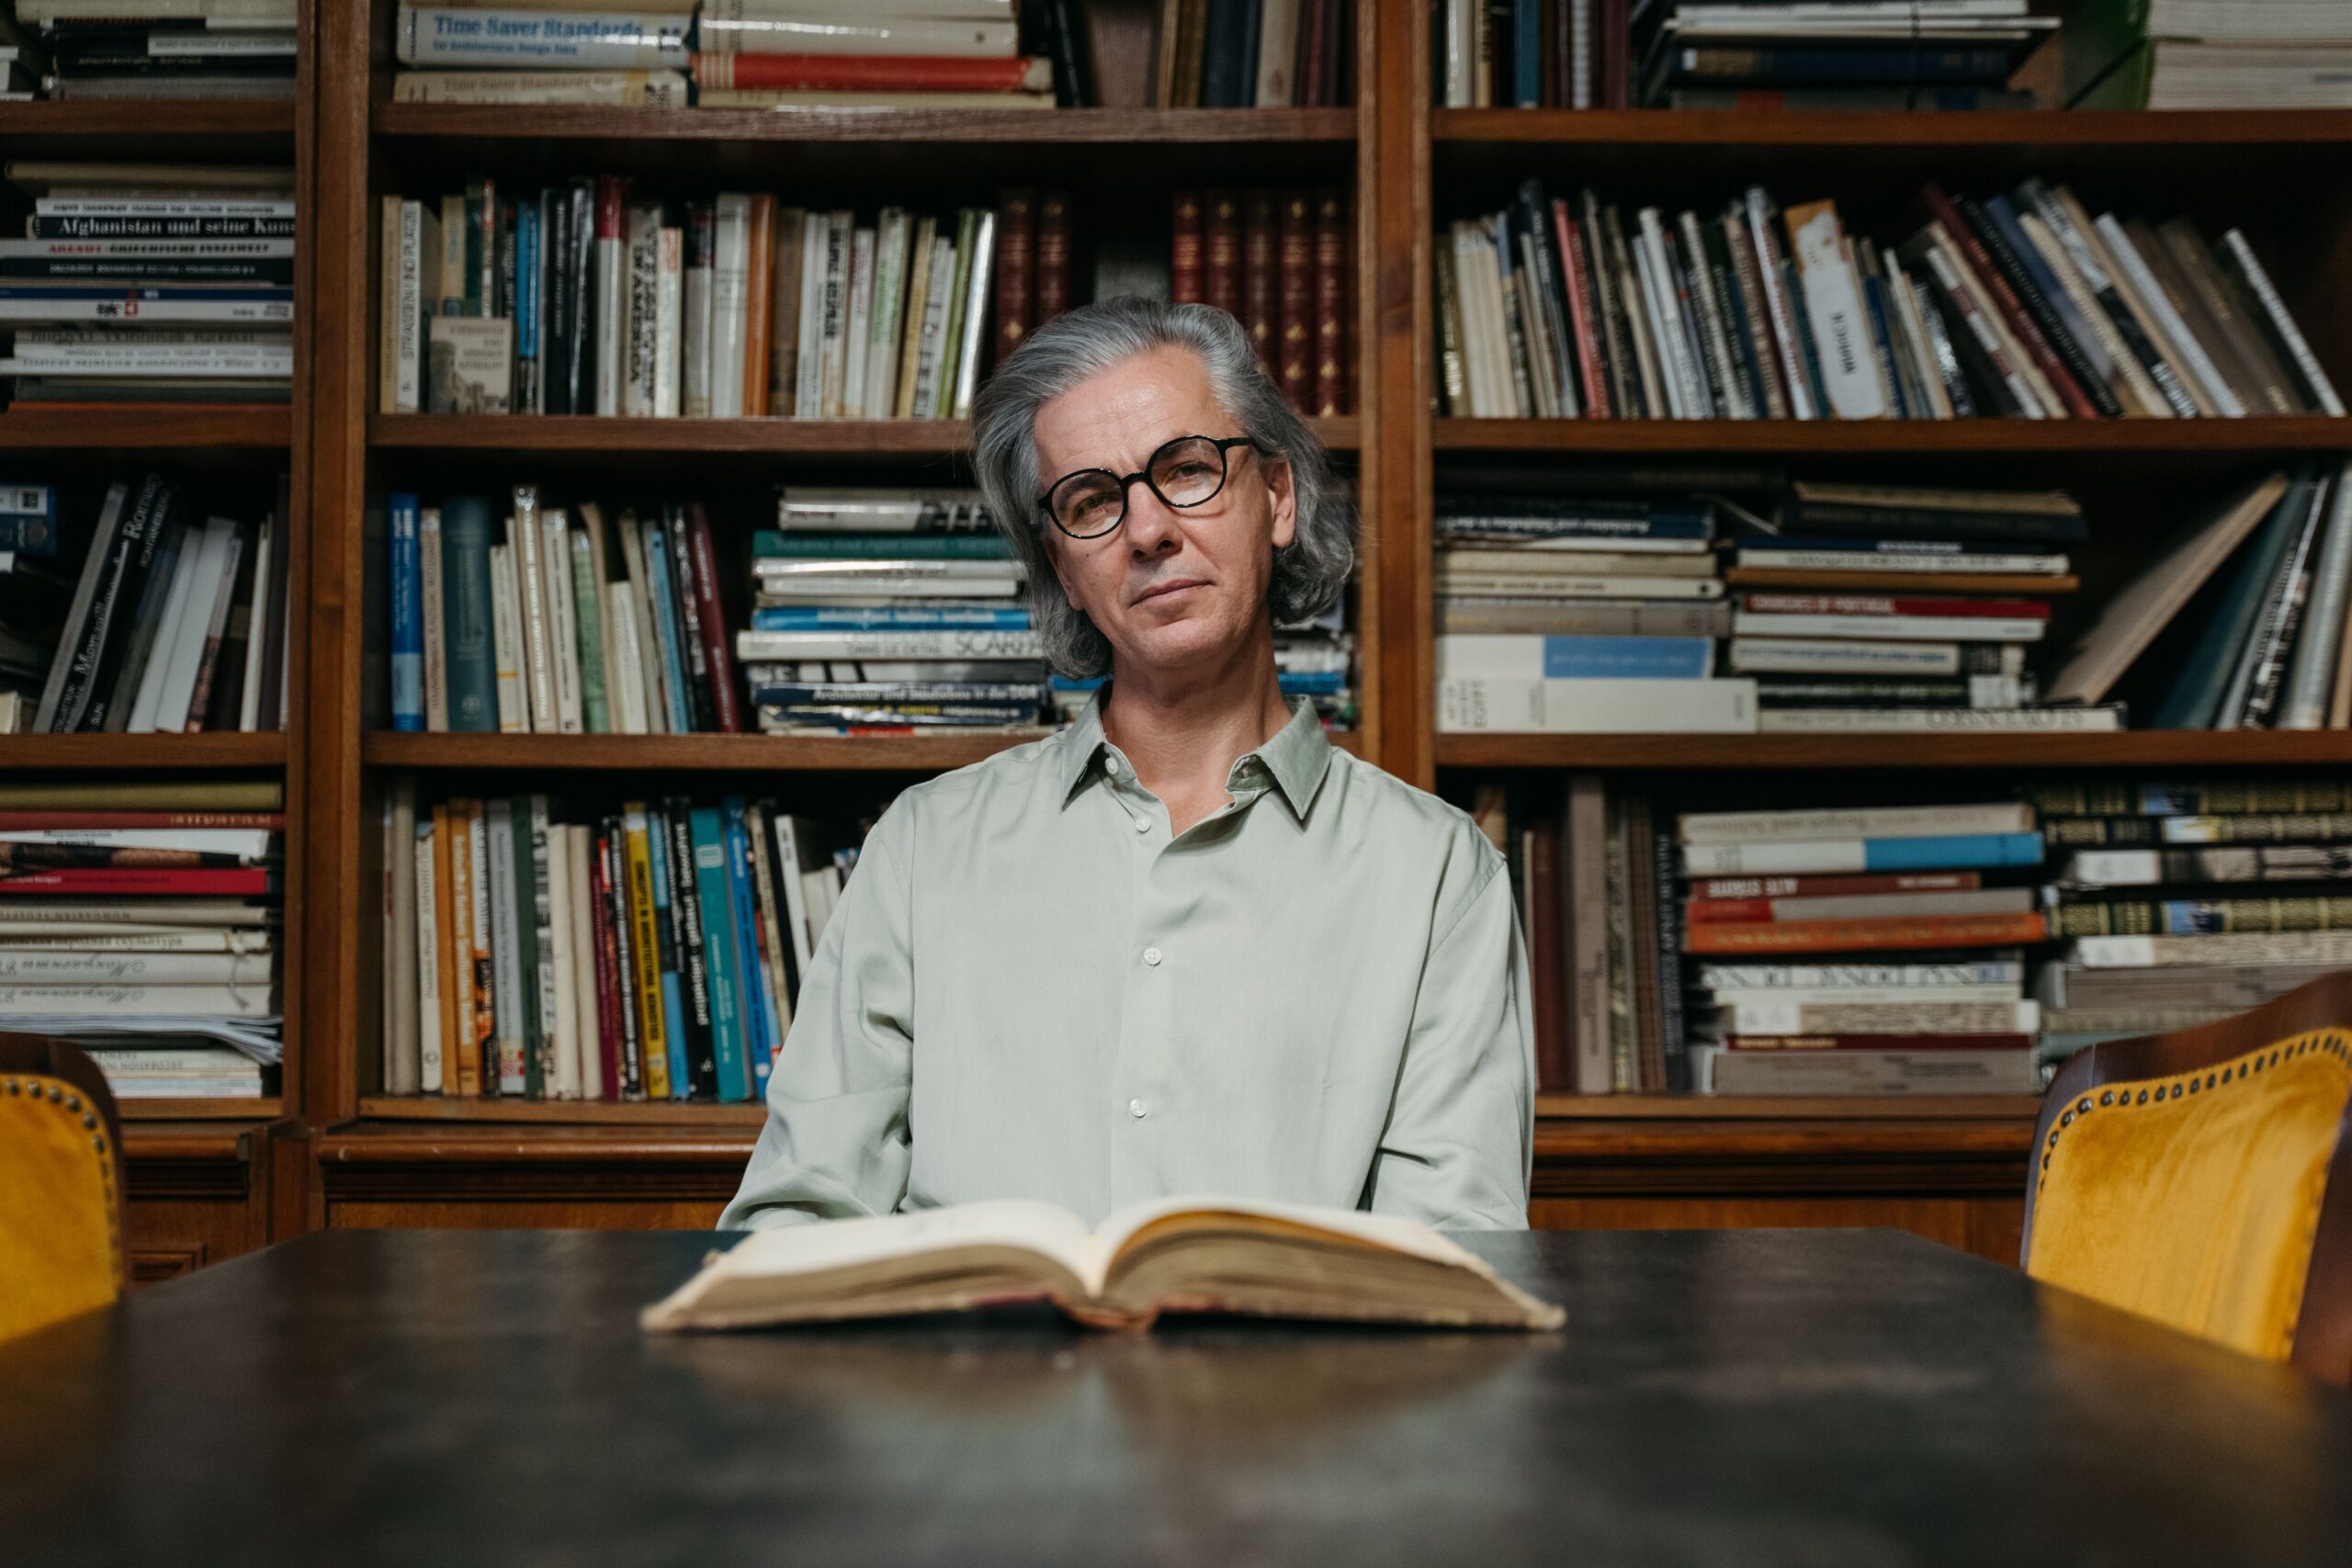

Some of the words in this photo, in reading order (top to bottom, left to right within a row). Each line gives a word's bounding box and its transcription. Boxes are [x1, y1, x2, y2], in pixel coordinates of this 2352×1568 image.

[434, 14, 481, 35] Time
[486, 16, 539, 36] Saver
[543, 17, 641, 37] Standards
[60, 218, 162, 236] Afghanistan
[167, 218, 200, 233] und
[206, 219, 249, 233] seine
